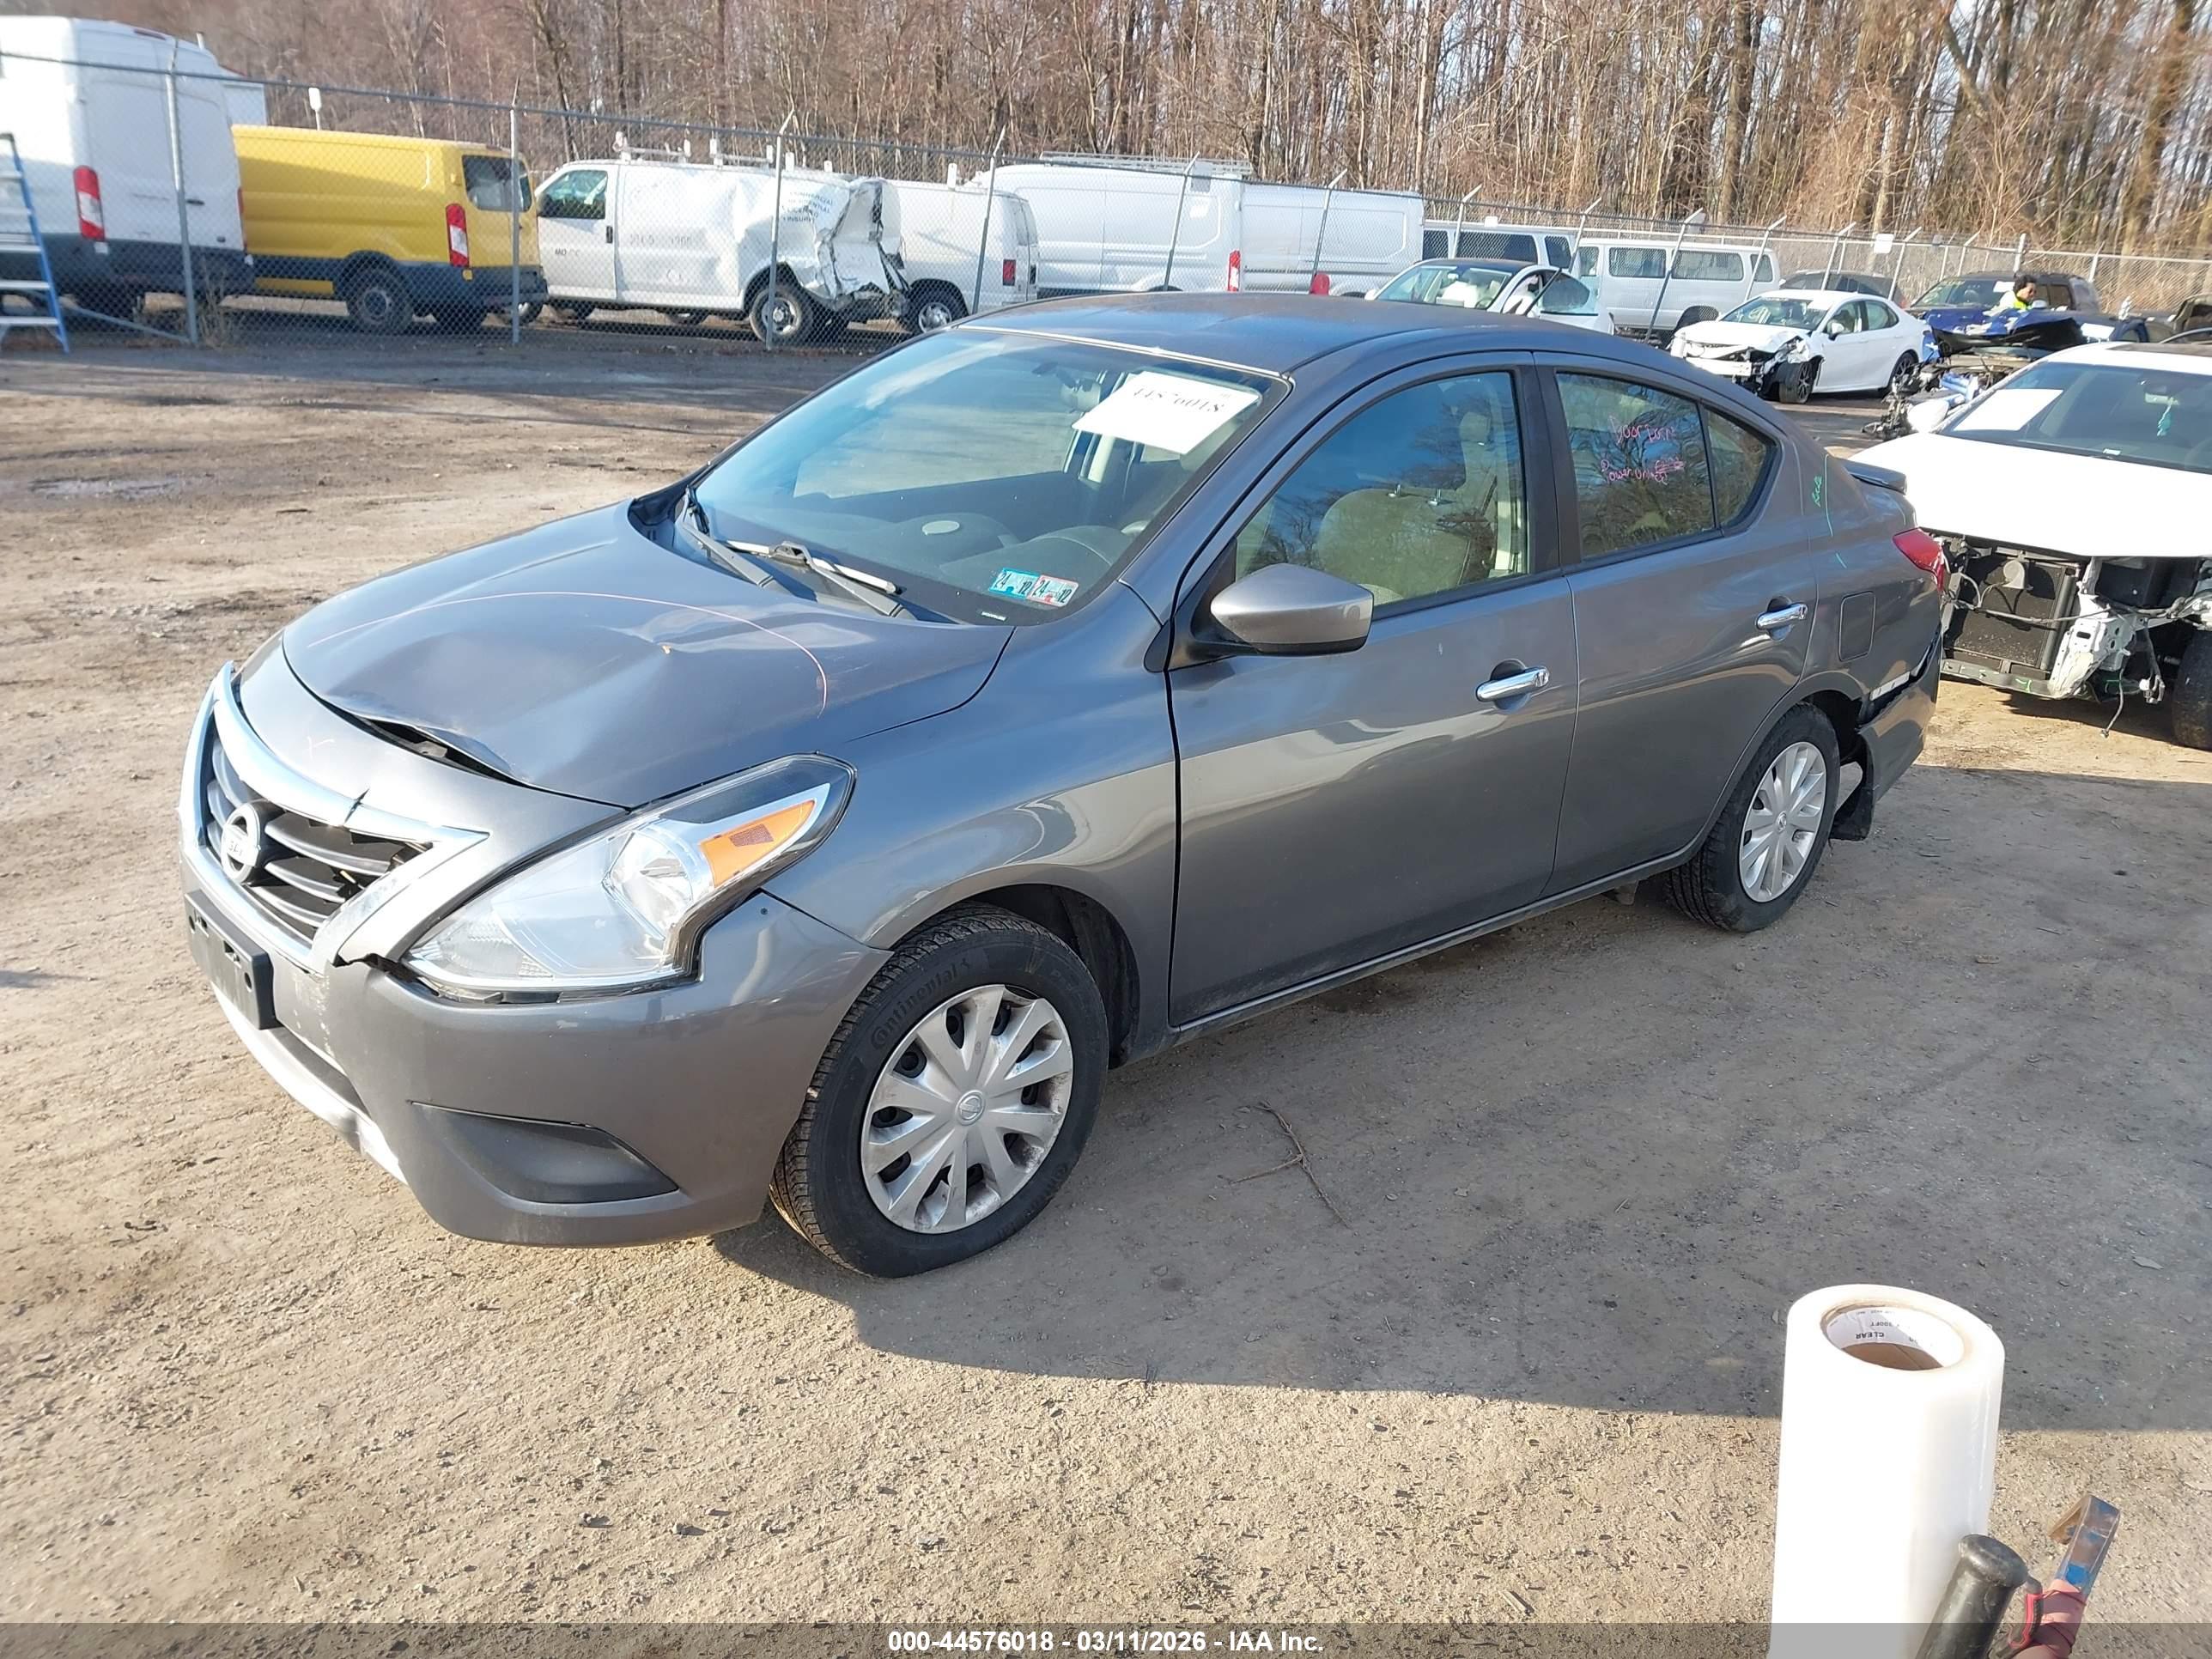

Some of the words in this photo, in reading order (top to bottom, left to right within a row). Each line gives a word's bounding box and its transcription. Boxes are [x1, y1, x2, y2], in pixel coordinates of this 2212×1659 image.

[1057, 588, 1072, 603] 12
[872, 962, 958, 1049] Continental
[1855, 1331, 1885, 1340] CLEAR
